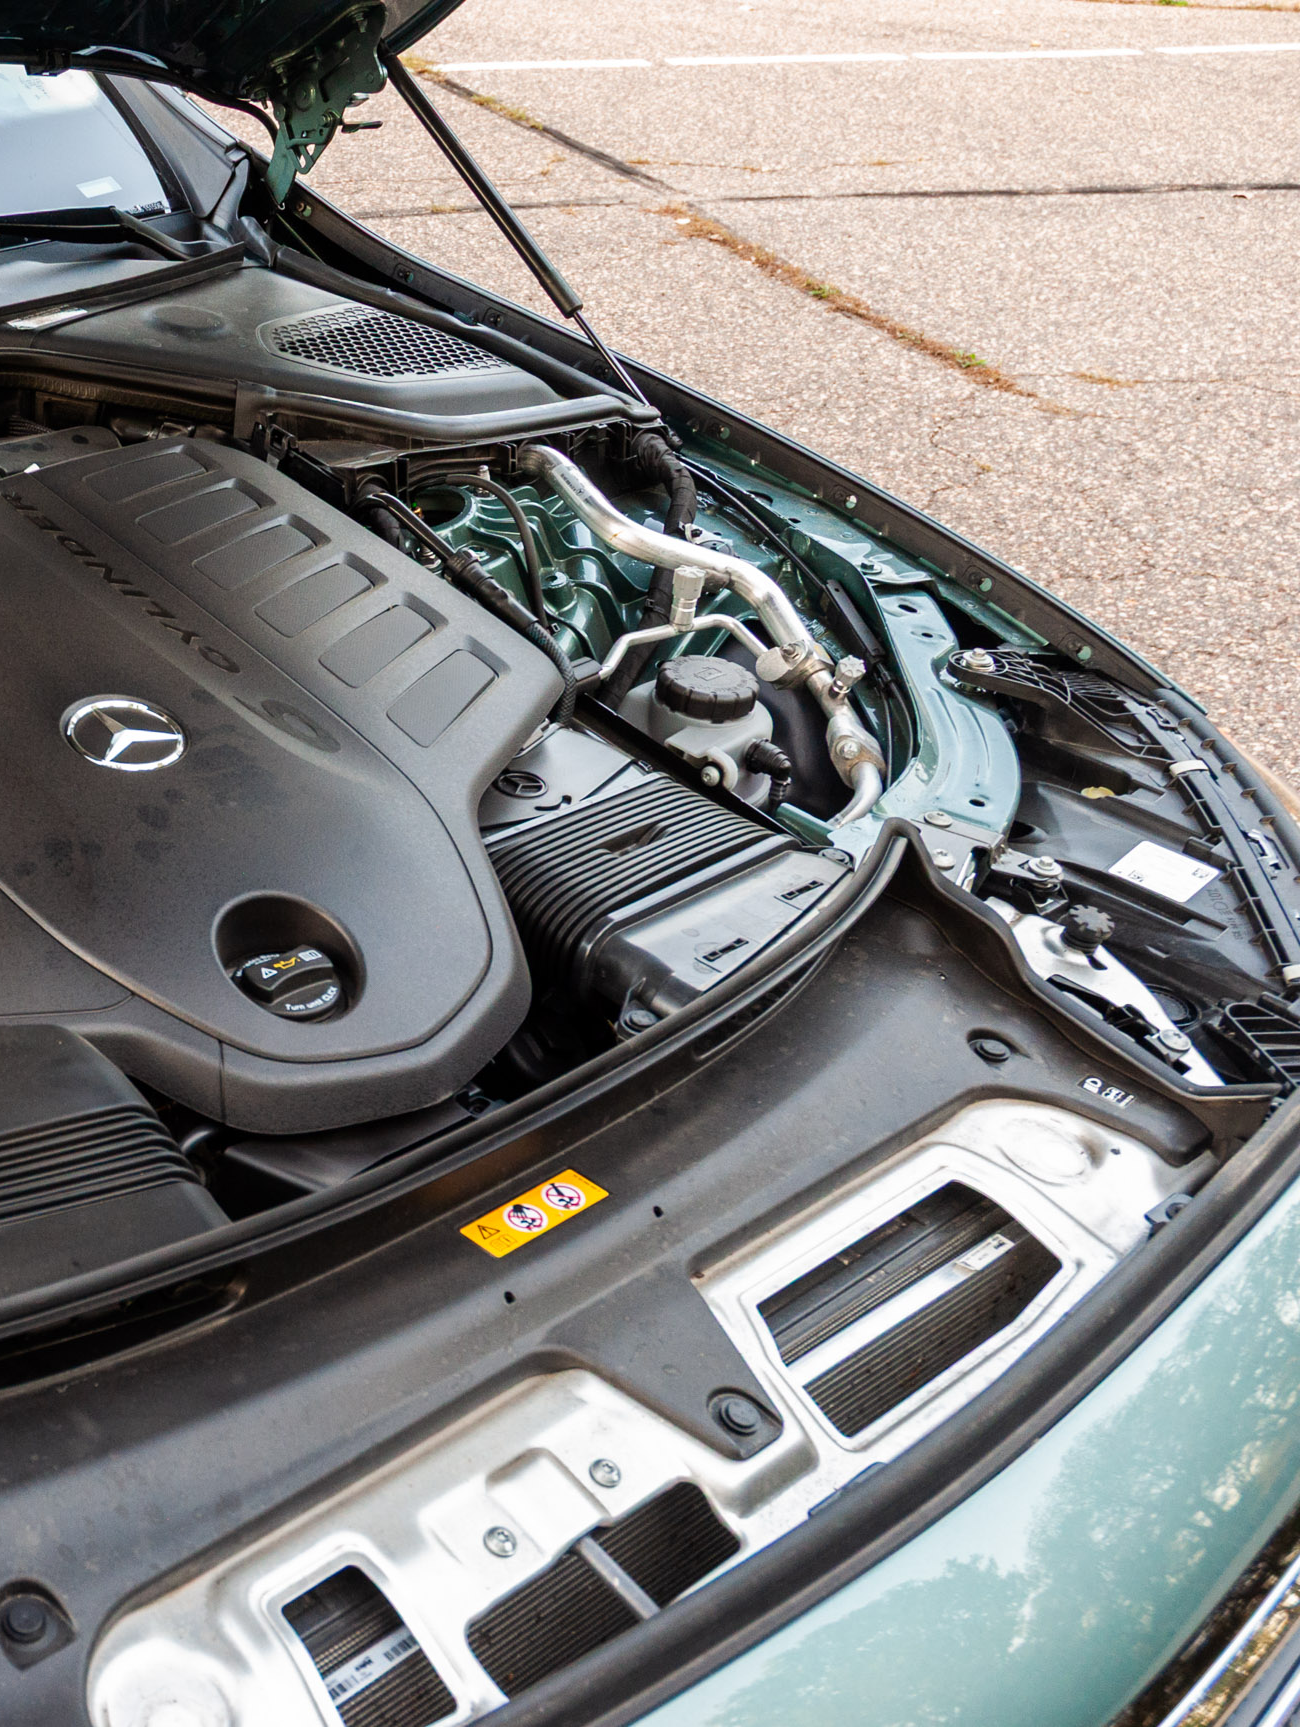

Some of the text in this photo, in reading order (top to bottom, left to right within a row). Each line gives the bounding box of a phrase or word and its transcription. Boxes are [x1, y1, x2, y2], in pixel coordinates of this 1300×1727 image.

[0, 490, 241, 674] CYLINDER
[284, 985, 338, 1011] Turn until CLICK
